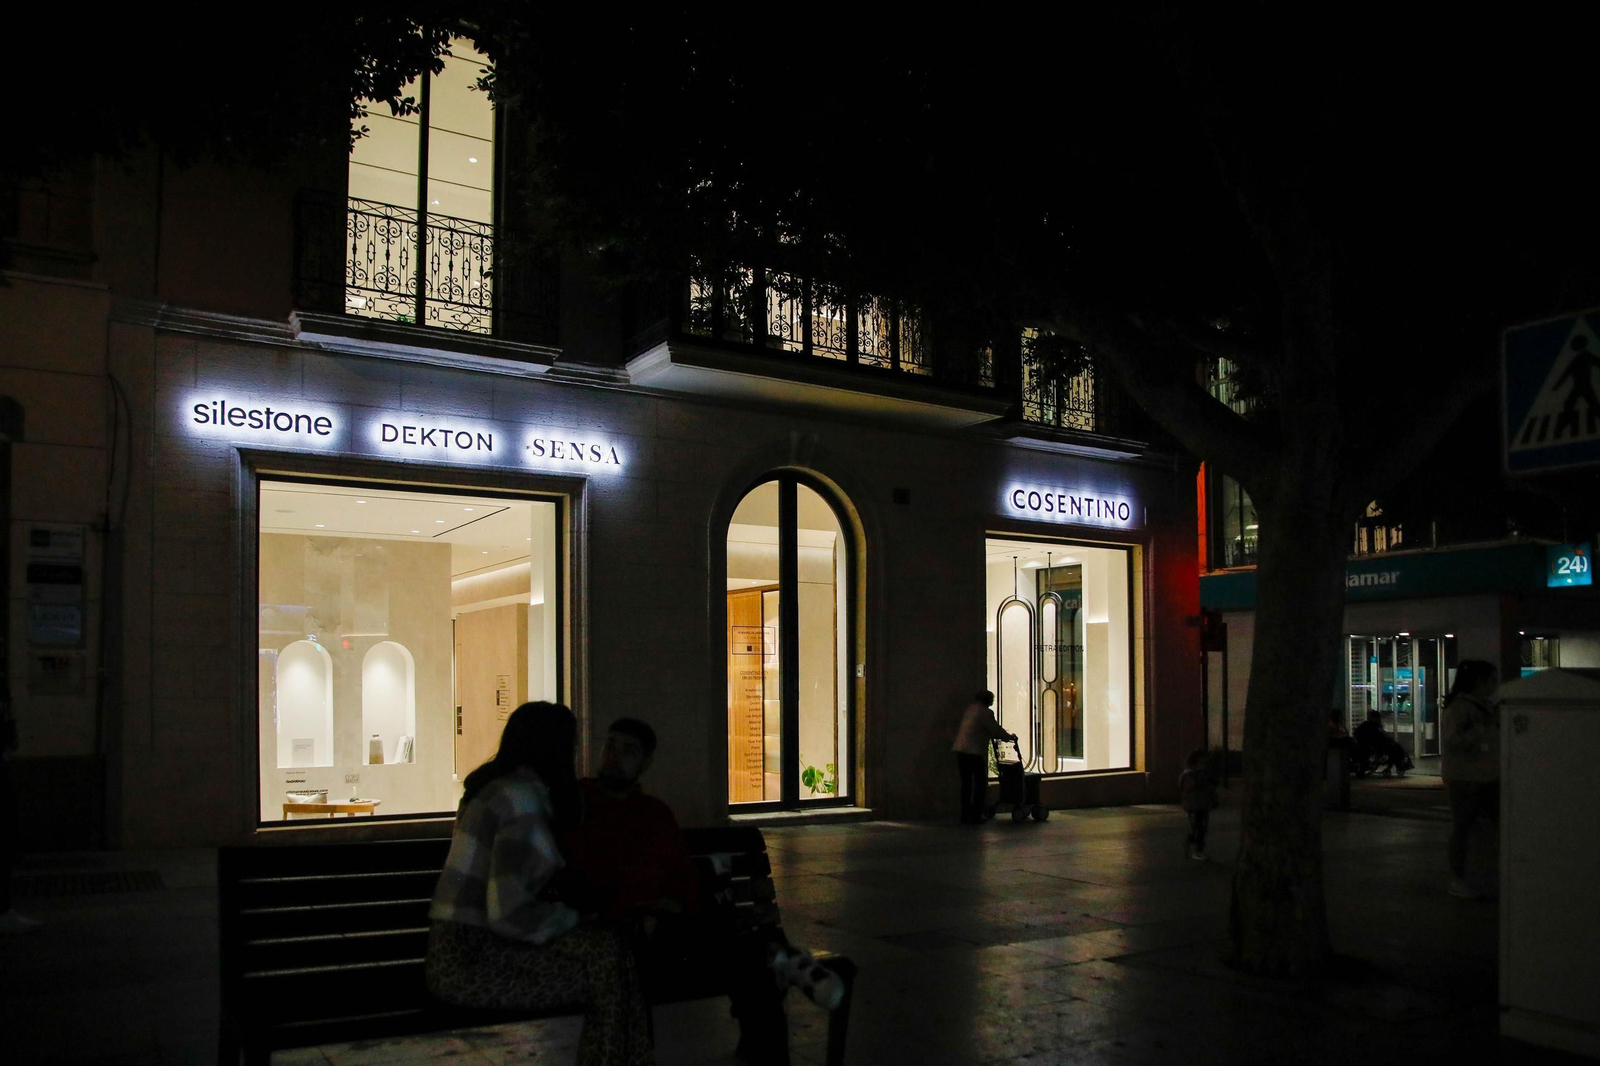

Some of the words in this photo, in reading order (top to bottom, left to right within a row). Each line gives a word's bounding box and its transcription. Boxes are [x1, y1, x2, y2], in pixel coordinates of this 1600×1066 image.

[193, 400, 332, 436] silestone
[382, 423, 493, 452] DEKTON
[532, 438, 621, 465] SENSA
[1013, 489, 1130, 521] COSENTINO
